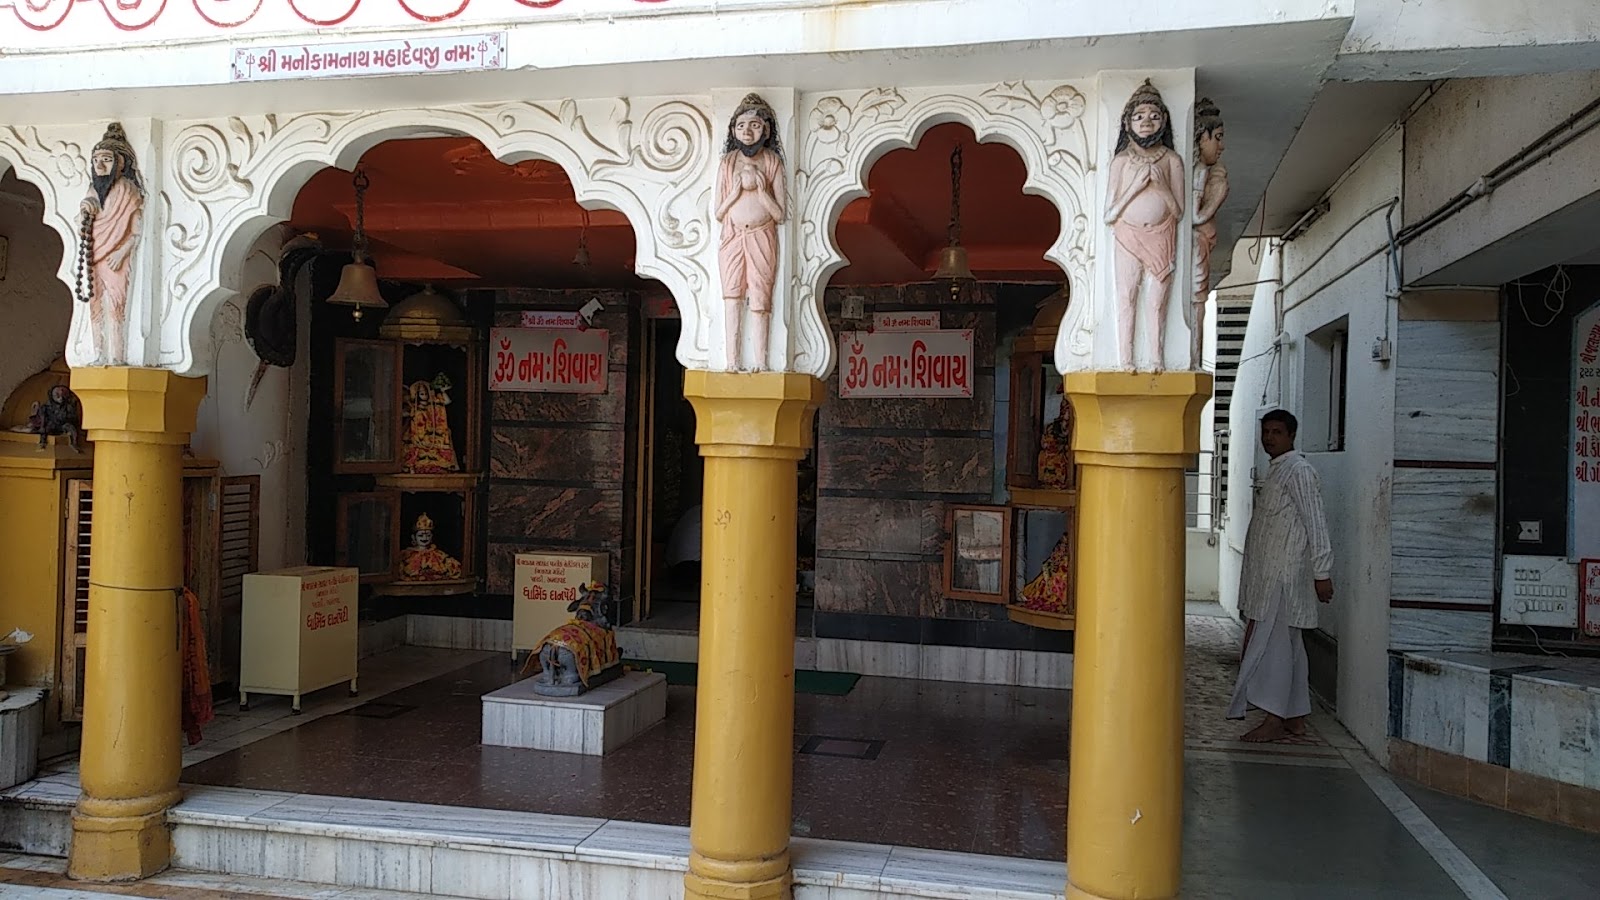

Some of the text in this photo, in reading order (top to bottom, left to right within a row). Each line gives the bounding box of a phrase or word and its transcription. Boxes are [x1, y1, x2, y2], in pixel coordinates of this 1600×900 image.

[257, 48, 276, 72] શ્રી
[281, 47, 369, 71] મનોકામનાથ
[373, 40, 440, 69] મહાદેવજી
[1576, 385, 1589, 407] શ્રી
[1576, 410, 1589, 433] શ્રી
[1575, 436, 1589, 458] શ્રી
[1575, 461, 1589, 482] શ્રી
